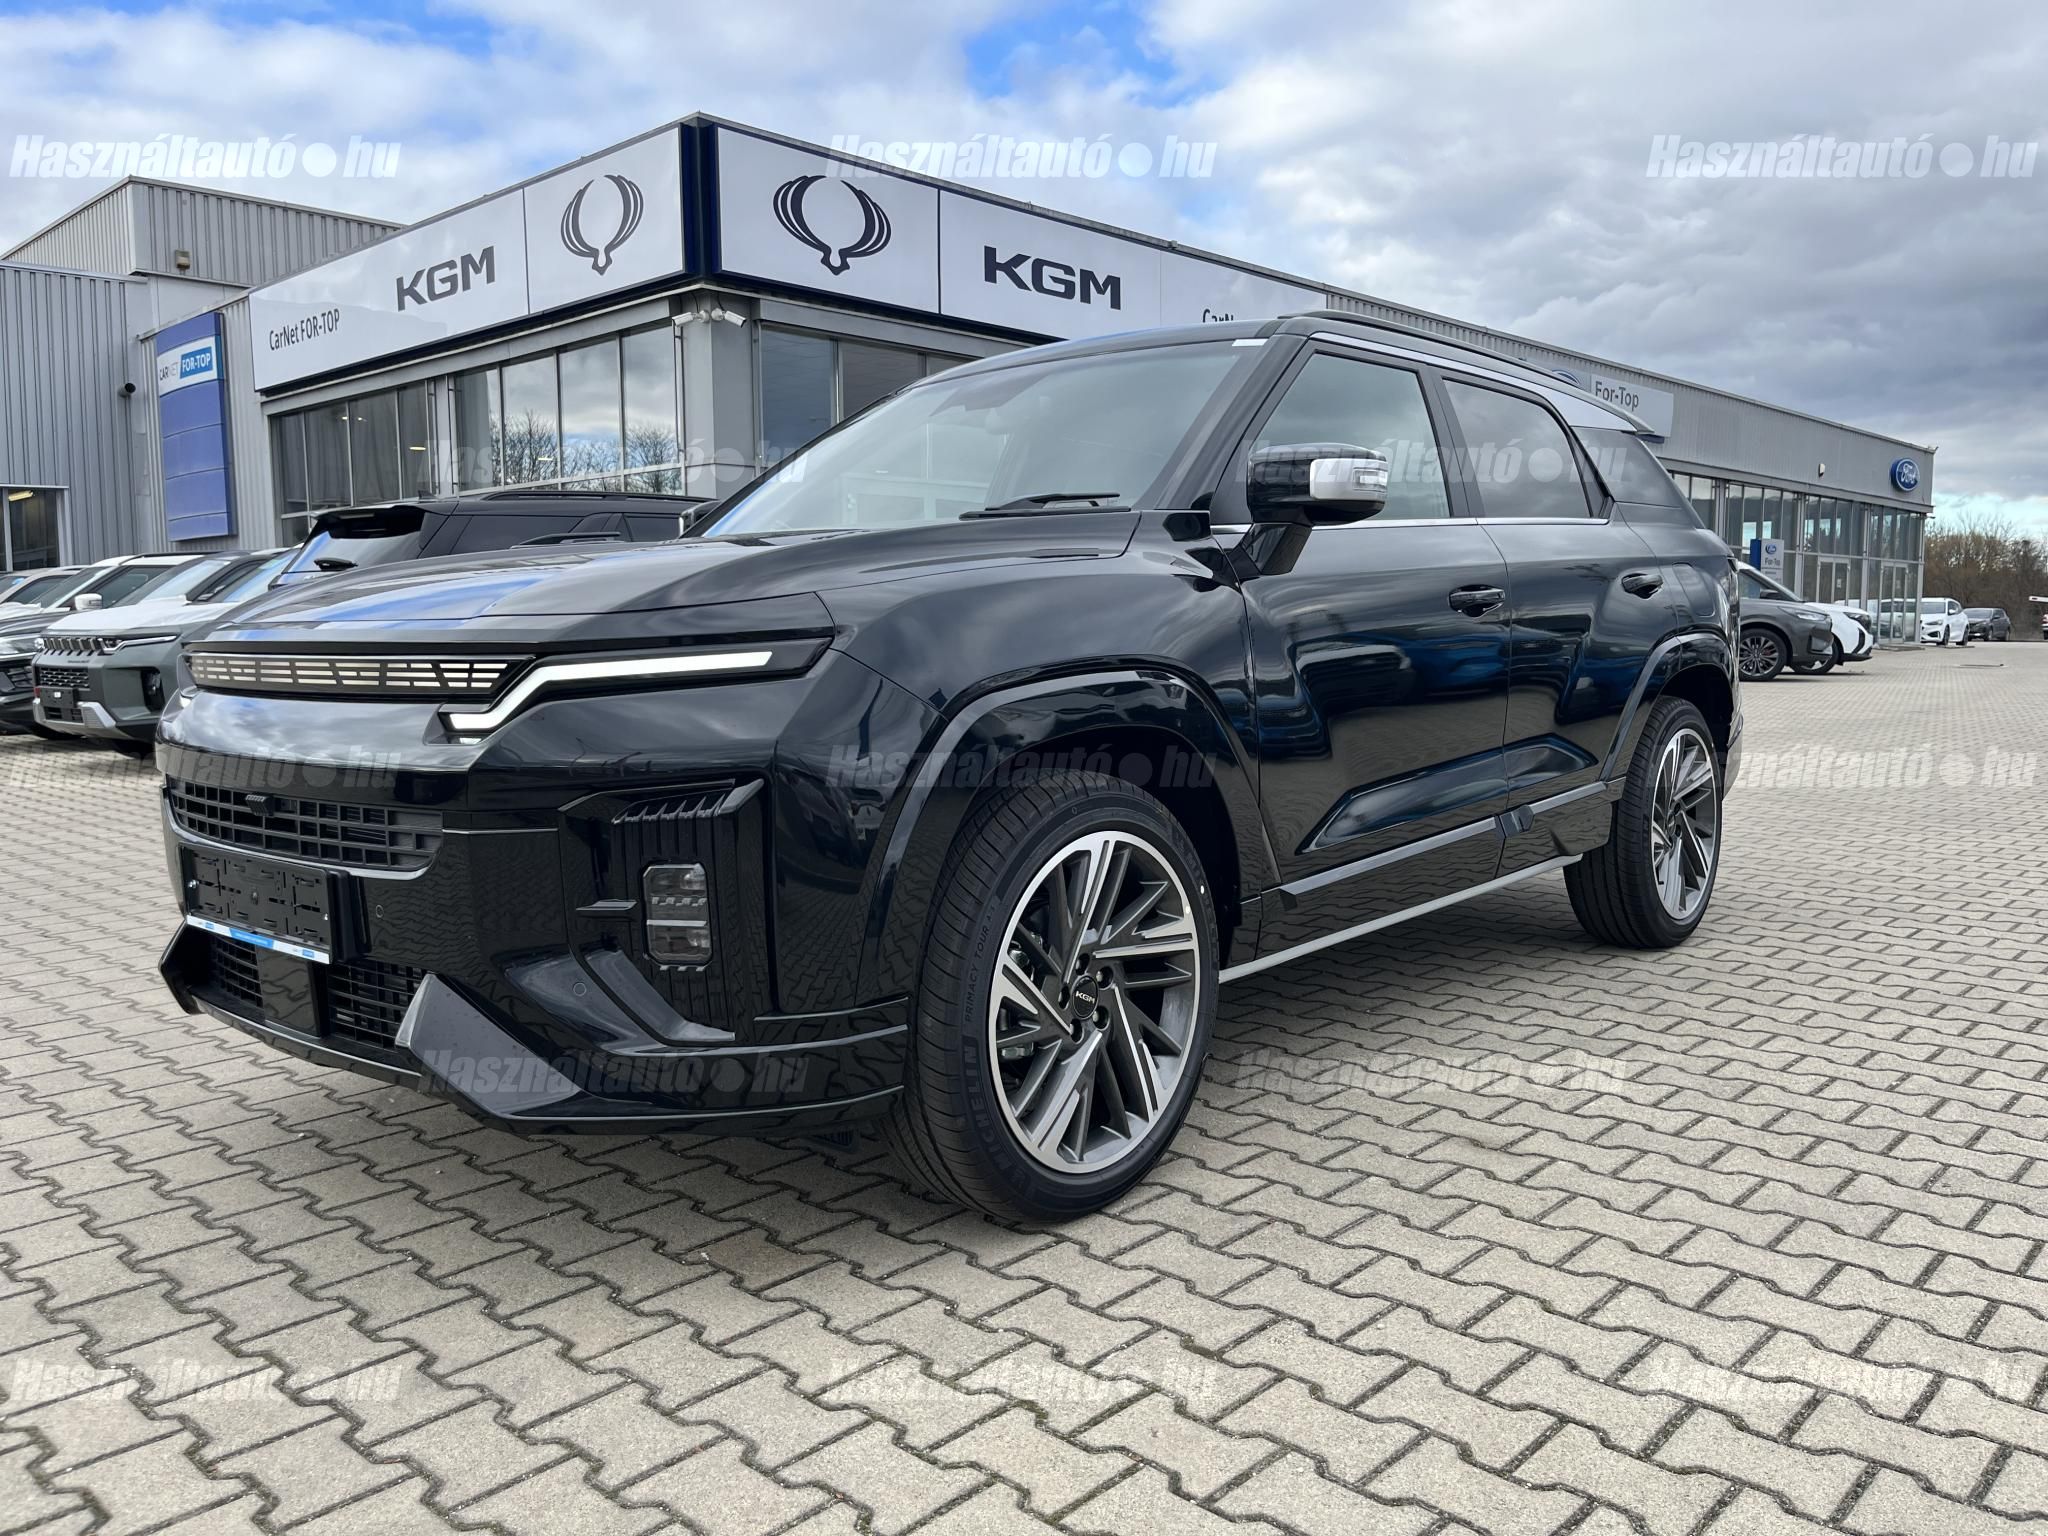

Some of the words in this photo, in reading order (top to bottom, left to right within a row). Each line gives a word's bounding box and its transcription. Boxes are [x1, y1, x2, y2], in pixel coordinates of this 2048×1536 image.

[396, 245, 495, 312] KGM
[984, 245, 1121, 310] KGM
[269, 325, 299, 351] CarNet
[300, 308, 340, 344] FOR-TOP
[182, 352, 211, 373] FOR-TOP
[1595, 381, 1639, 412] For-Top
[965, 963, 979, 1023] PRIMACY
[974, 925, 990, 960] TOUR
[1075, 990, 1095, 1004] KGM
